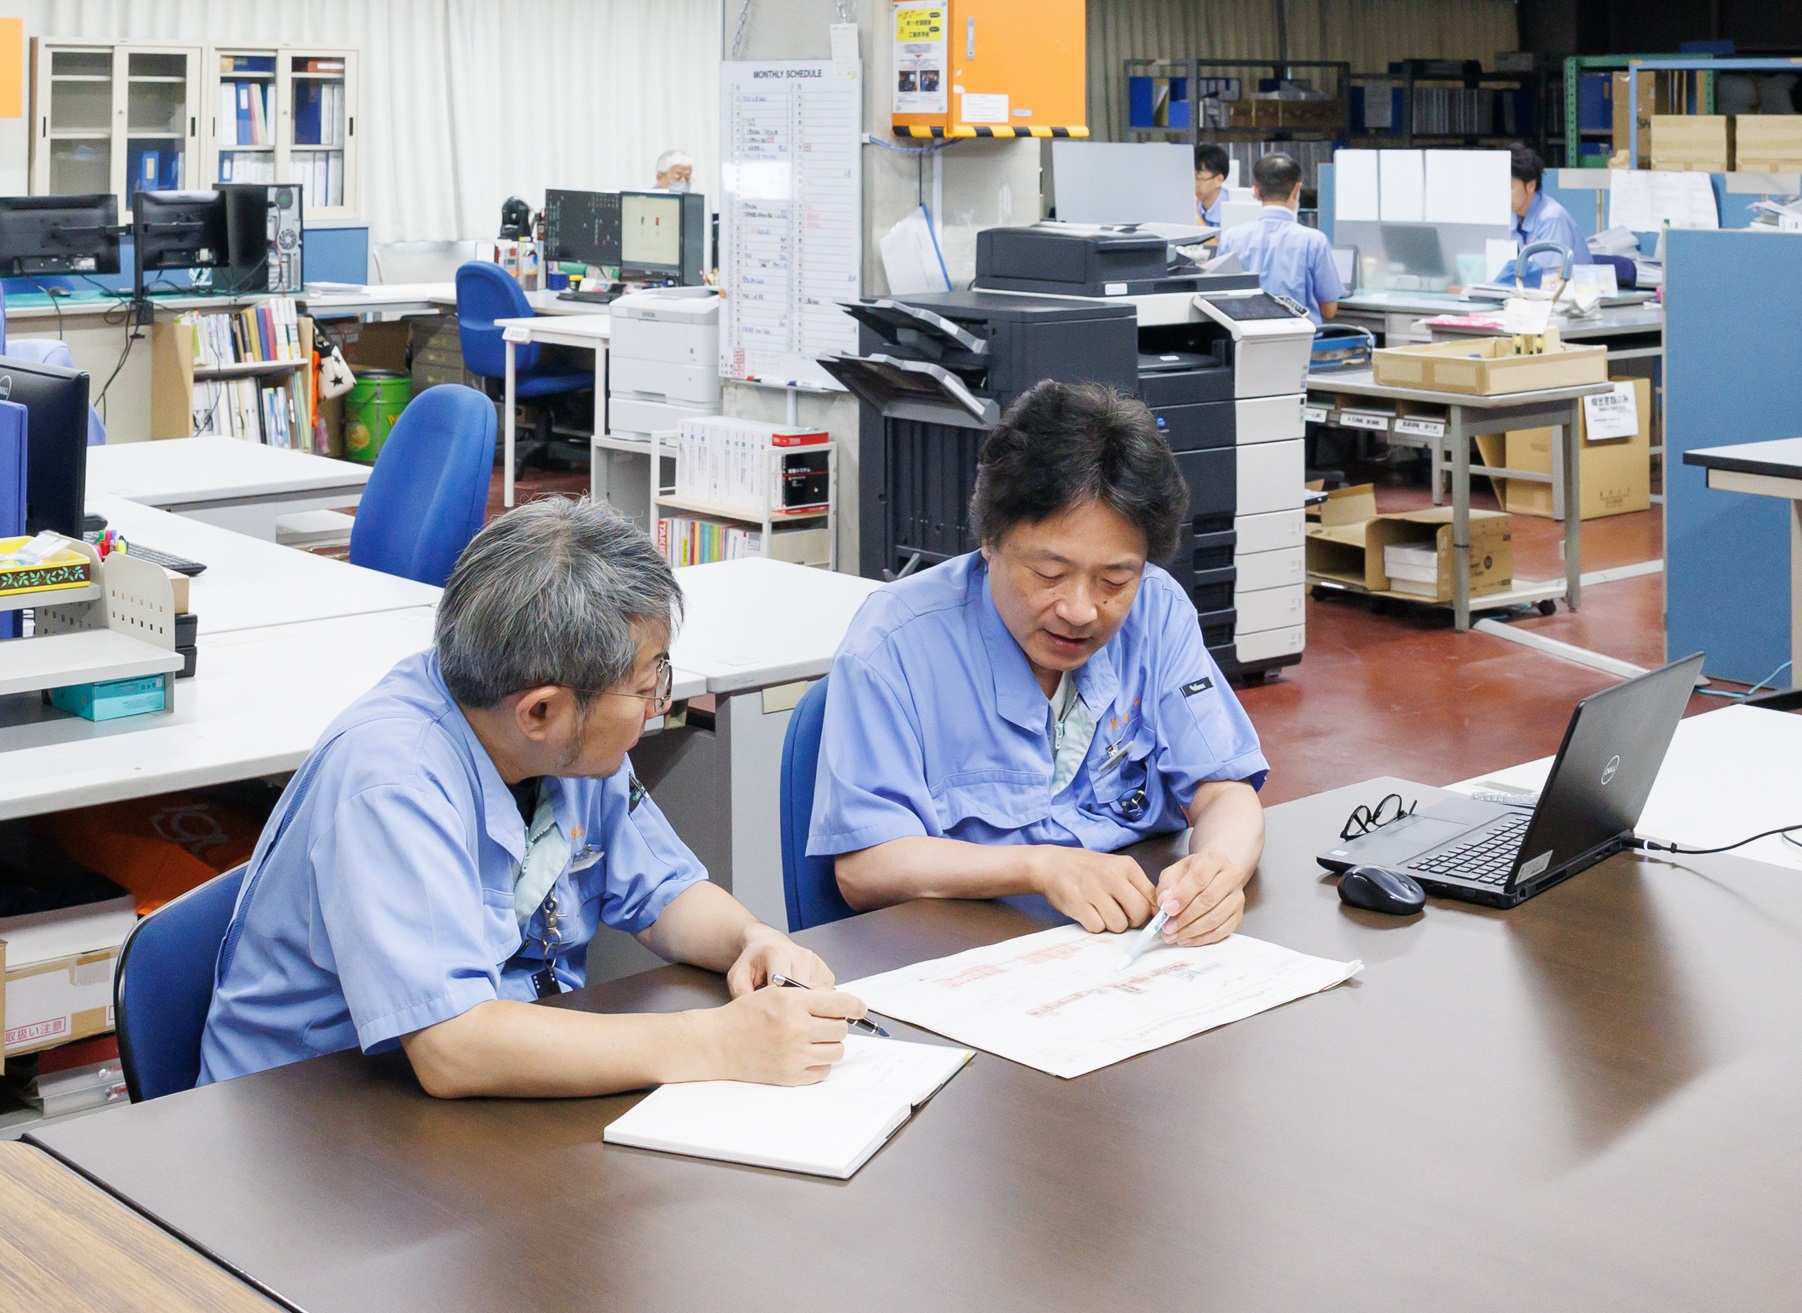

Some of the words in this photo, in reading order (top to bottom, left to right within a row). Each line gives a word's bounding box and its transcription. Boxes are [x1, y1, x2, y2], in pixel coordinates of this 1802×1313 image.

[753, 70, 784, 79] MONTHLY
[786, 69, 822, 78] SCHEDULE
[5, 1021, 63, 1043] 取扱い注意
